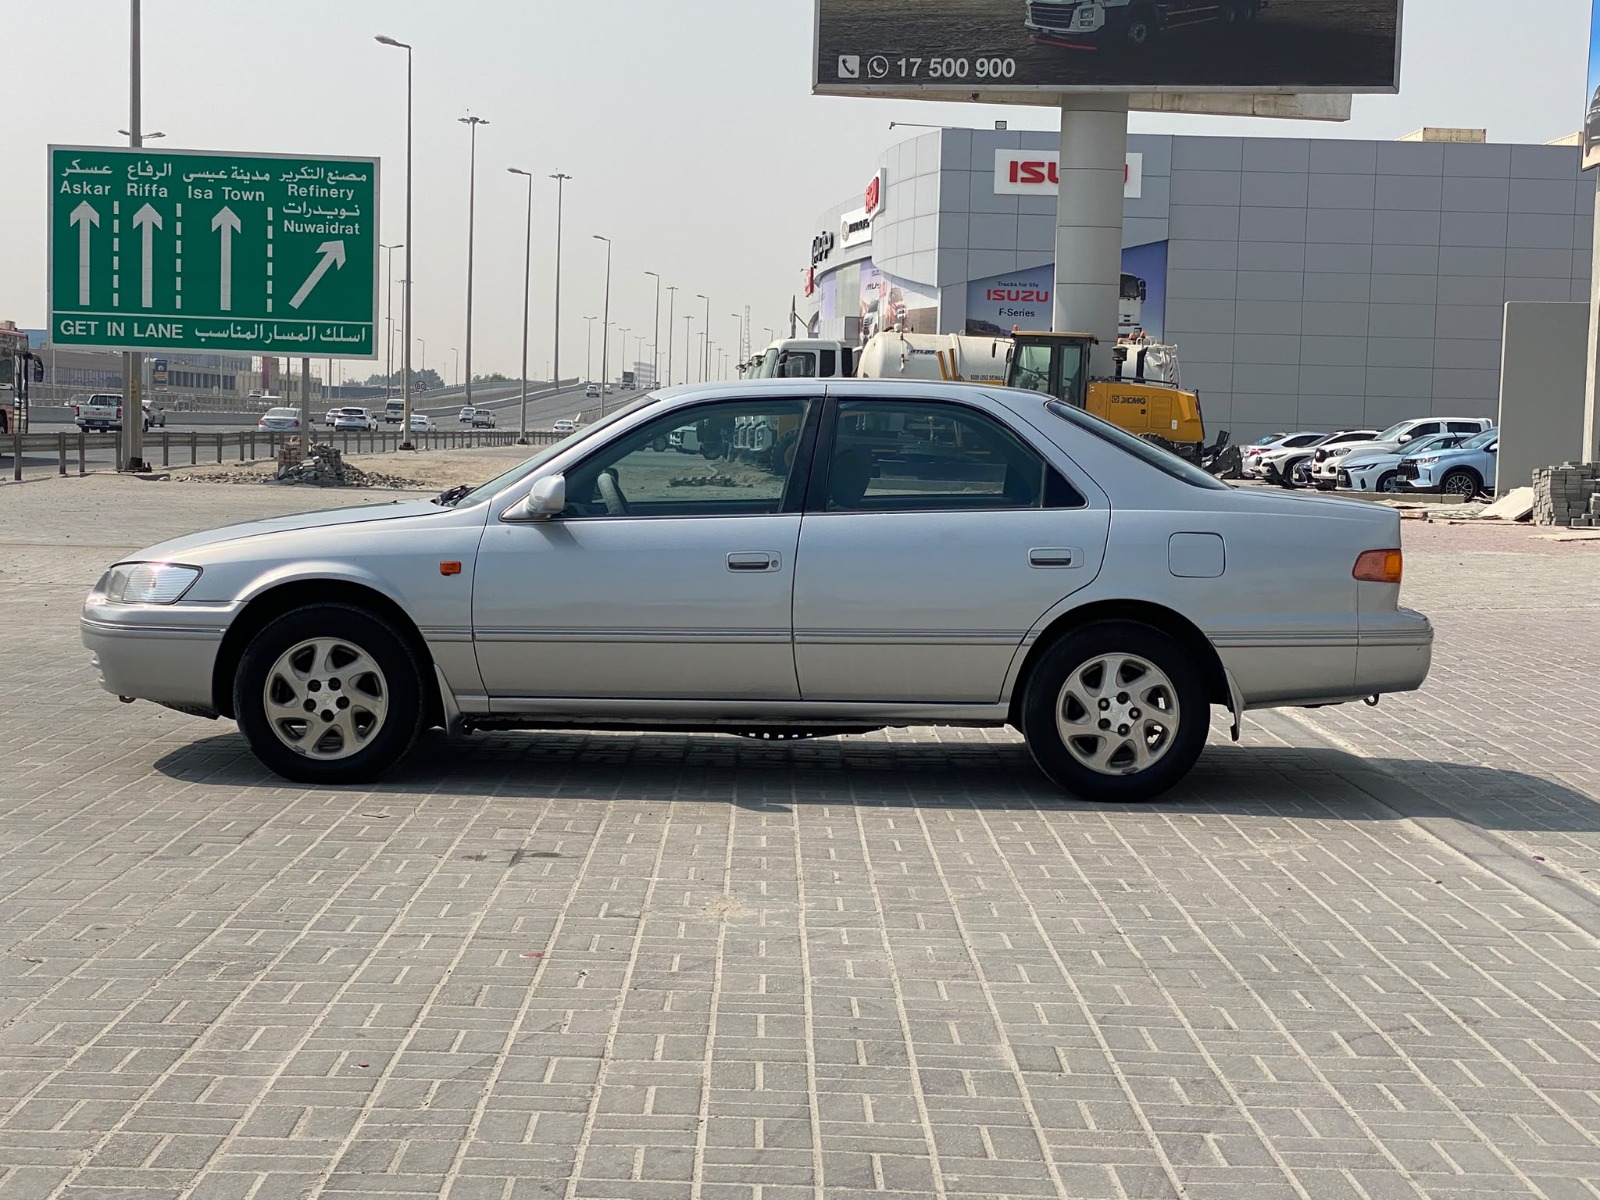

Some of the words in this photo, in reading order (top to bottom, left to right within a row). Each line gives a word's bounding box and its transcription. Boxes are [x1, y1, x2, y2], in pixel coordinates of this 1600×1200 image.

[897, 57, 922, 77] 17
[928, 57, 969, 78] 500
[975, 57, 1016, 78] 900
[61, 159, 113, 177] عسكر
[127, 160, 172, 180] الرفاع
[182, 168, 228, 183] عيسى
[231, 166, 270, 184] مدينة
[279, 166, 324, 183] التكرير
[326, 170, 367, 185] مصنع
[60, 180, 111, 196] Askar
[127, 183, 168, 198] Riffa
[188, 186, 213, 200] Isa
[221, 187, 265, 202] Town
[287, 183, 355, 201] Refinery
[282, 201, 360, 219] نويدرات
[284, 219, 360, 235] Nuwaidrat
[986, 288, 1049, 302] ISUZU
[998, 307, 1035, 317] F-Series
[60, 320, 99, 337] GET
[107, 321, 125, 337] IN
[133, 322, 184, 339] LANE
[194, 322, 263, 342] المناسب
[263, 324, 316, 344] المسار
[319, 325, 366, 343] اسلك
[1120, 396, 1147, 405] XCMG
